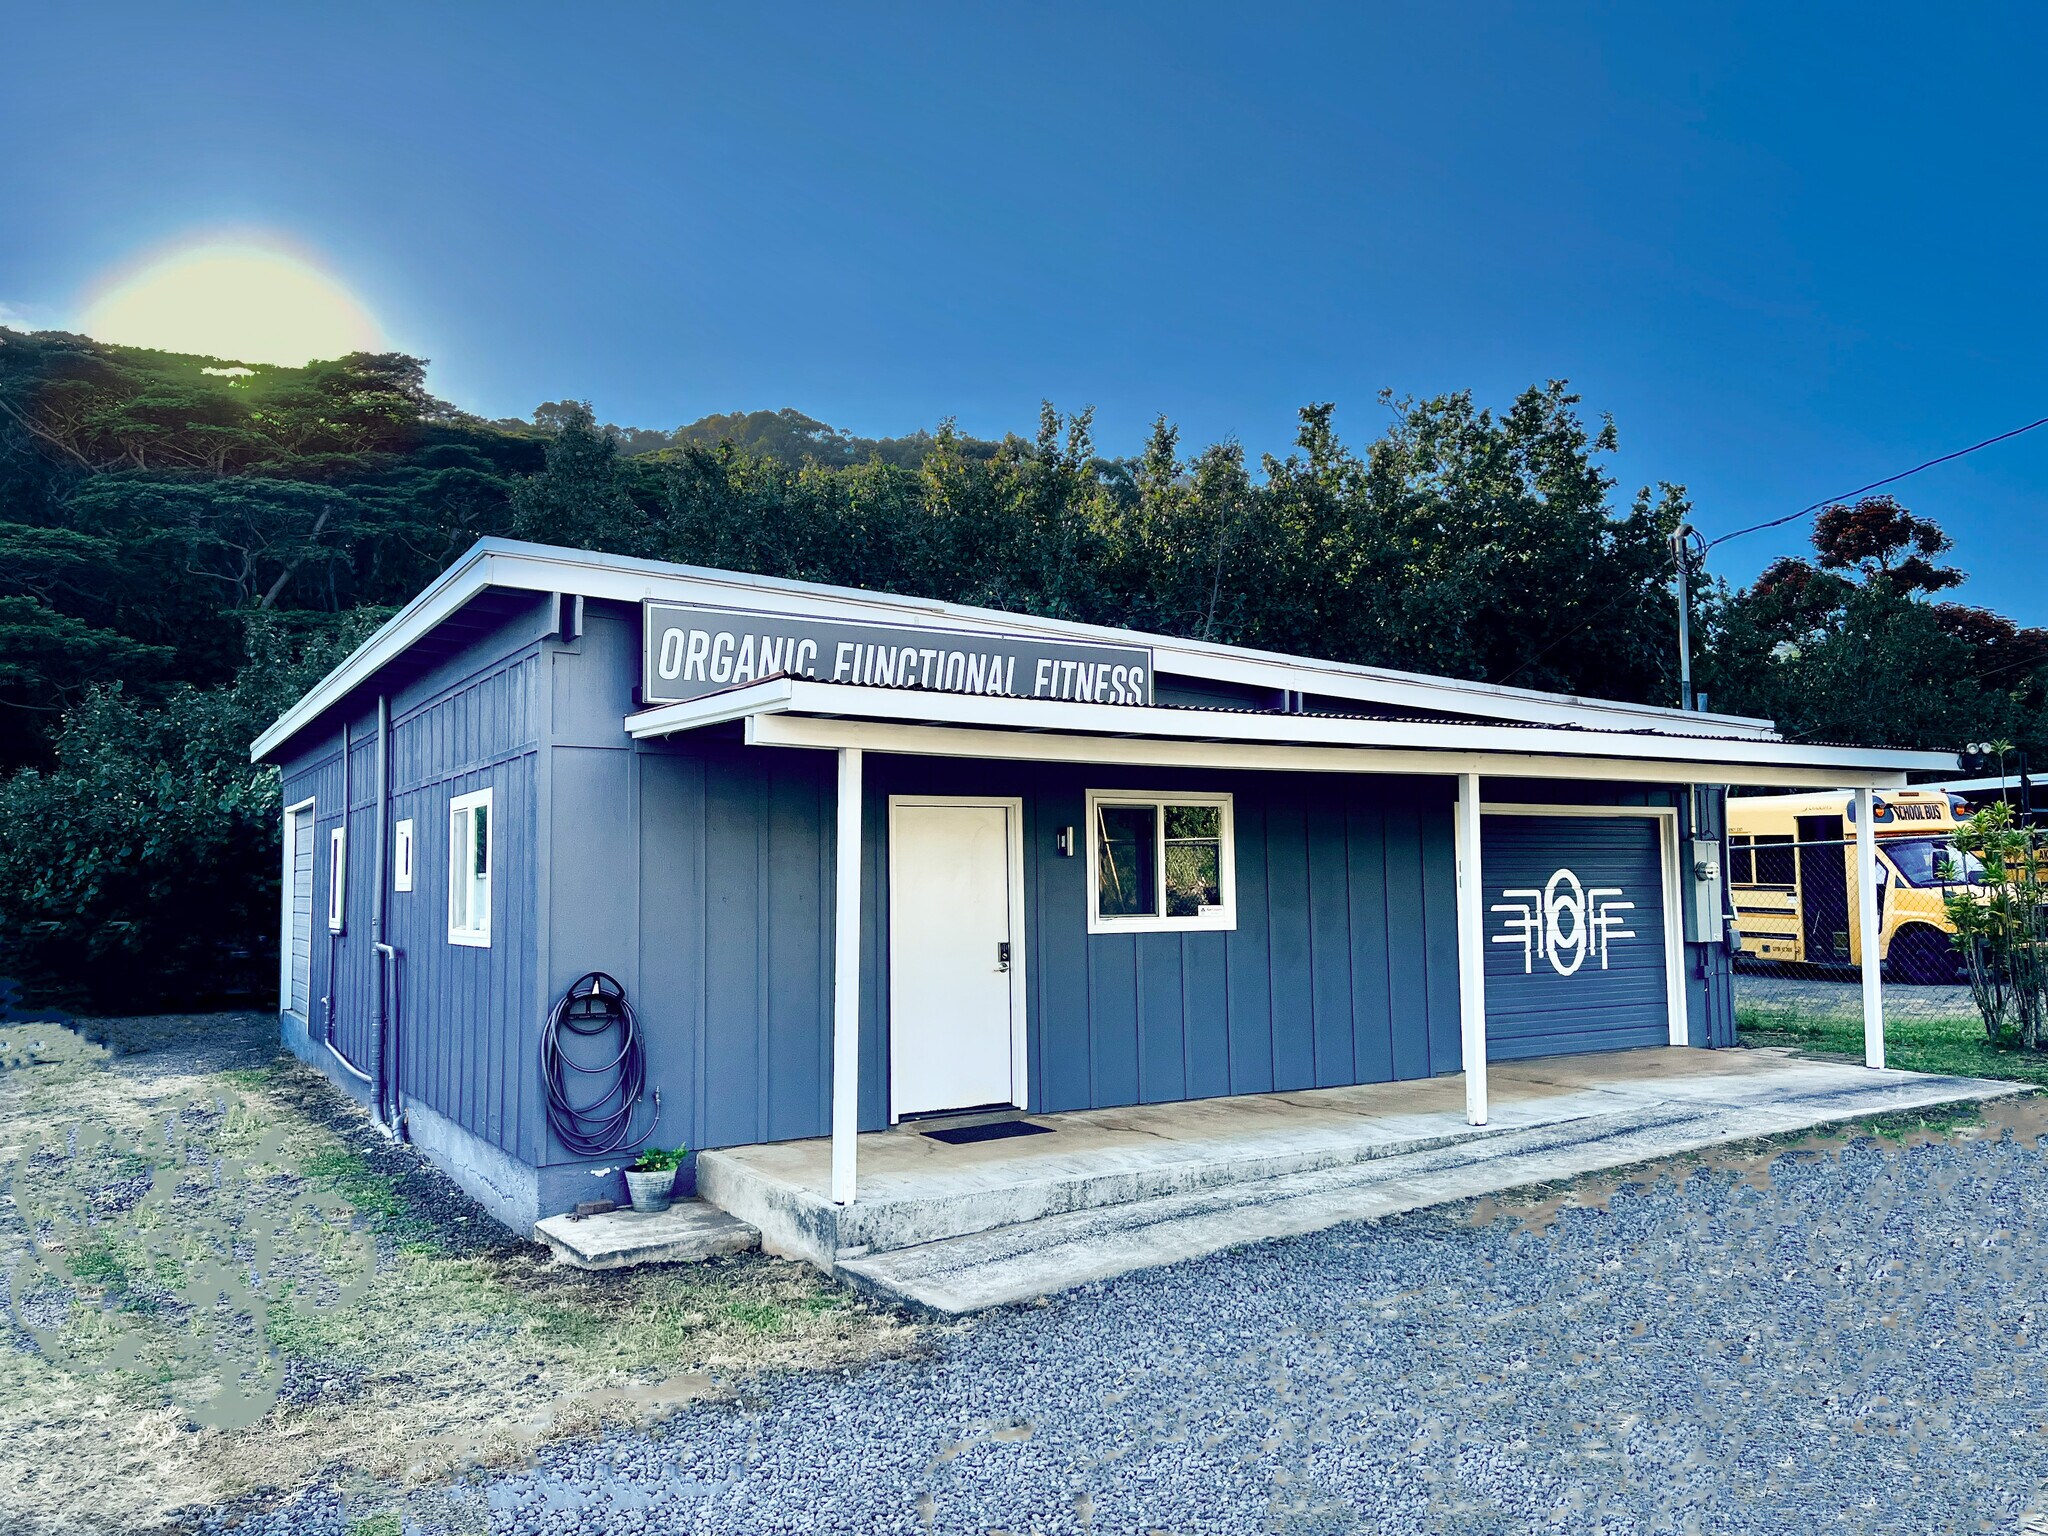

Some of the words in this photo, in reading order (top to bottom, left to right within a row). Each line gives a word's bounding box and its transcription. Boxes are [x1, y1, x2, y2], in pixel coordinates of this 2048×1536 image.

[658, 627, 818, 684] ORGANIC
[834, 642, 1015, 695] FUNCTIONAL
[1034, 659, 1144, 706] FITNESS
[1893, 805, 1925, 820] SCHOOL
[1924, 804, 1941, 820] BUS
